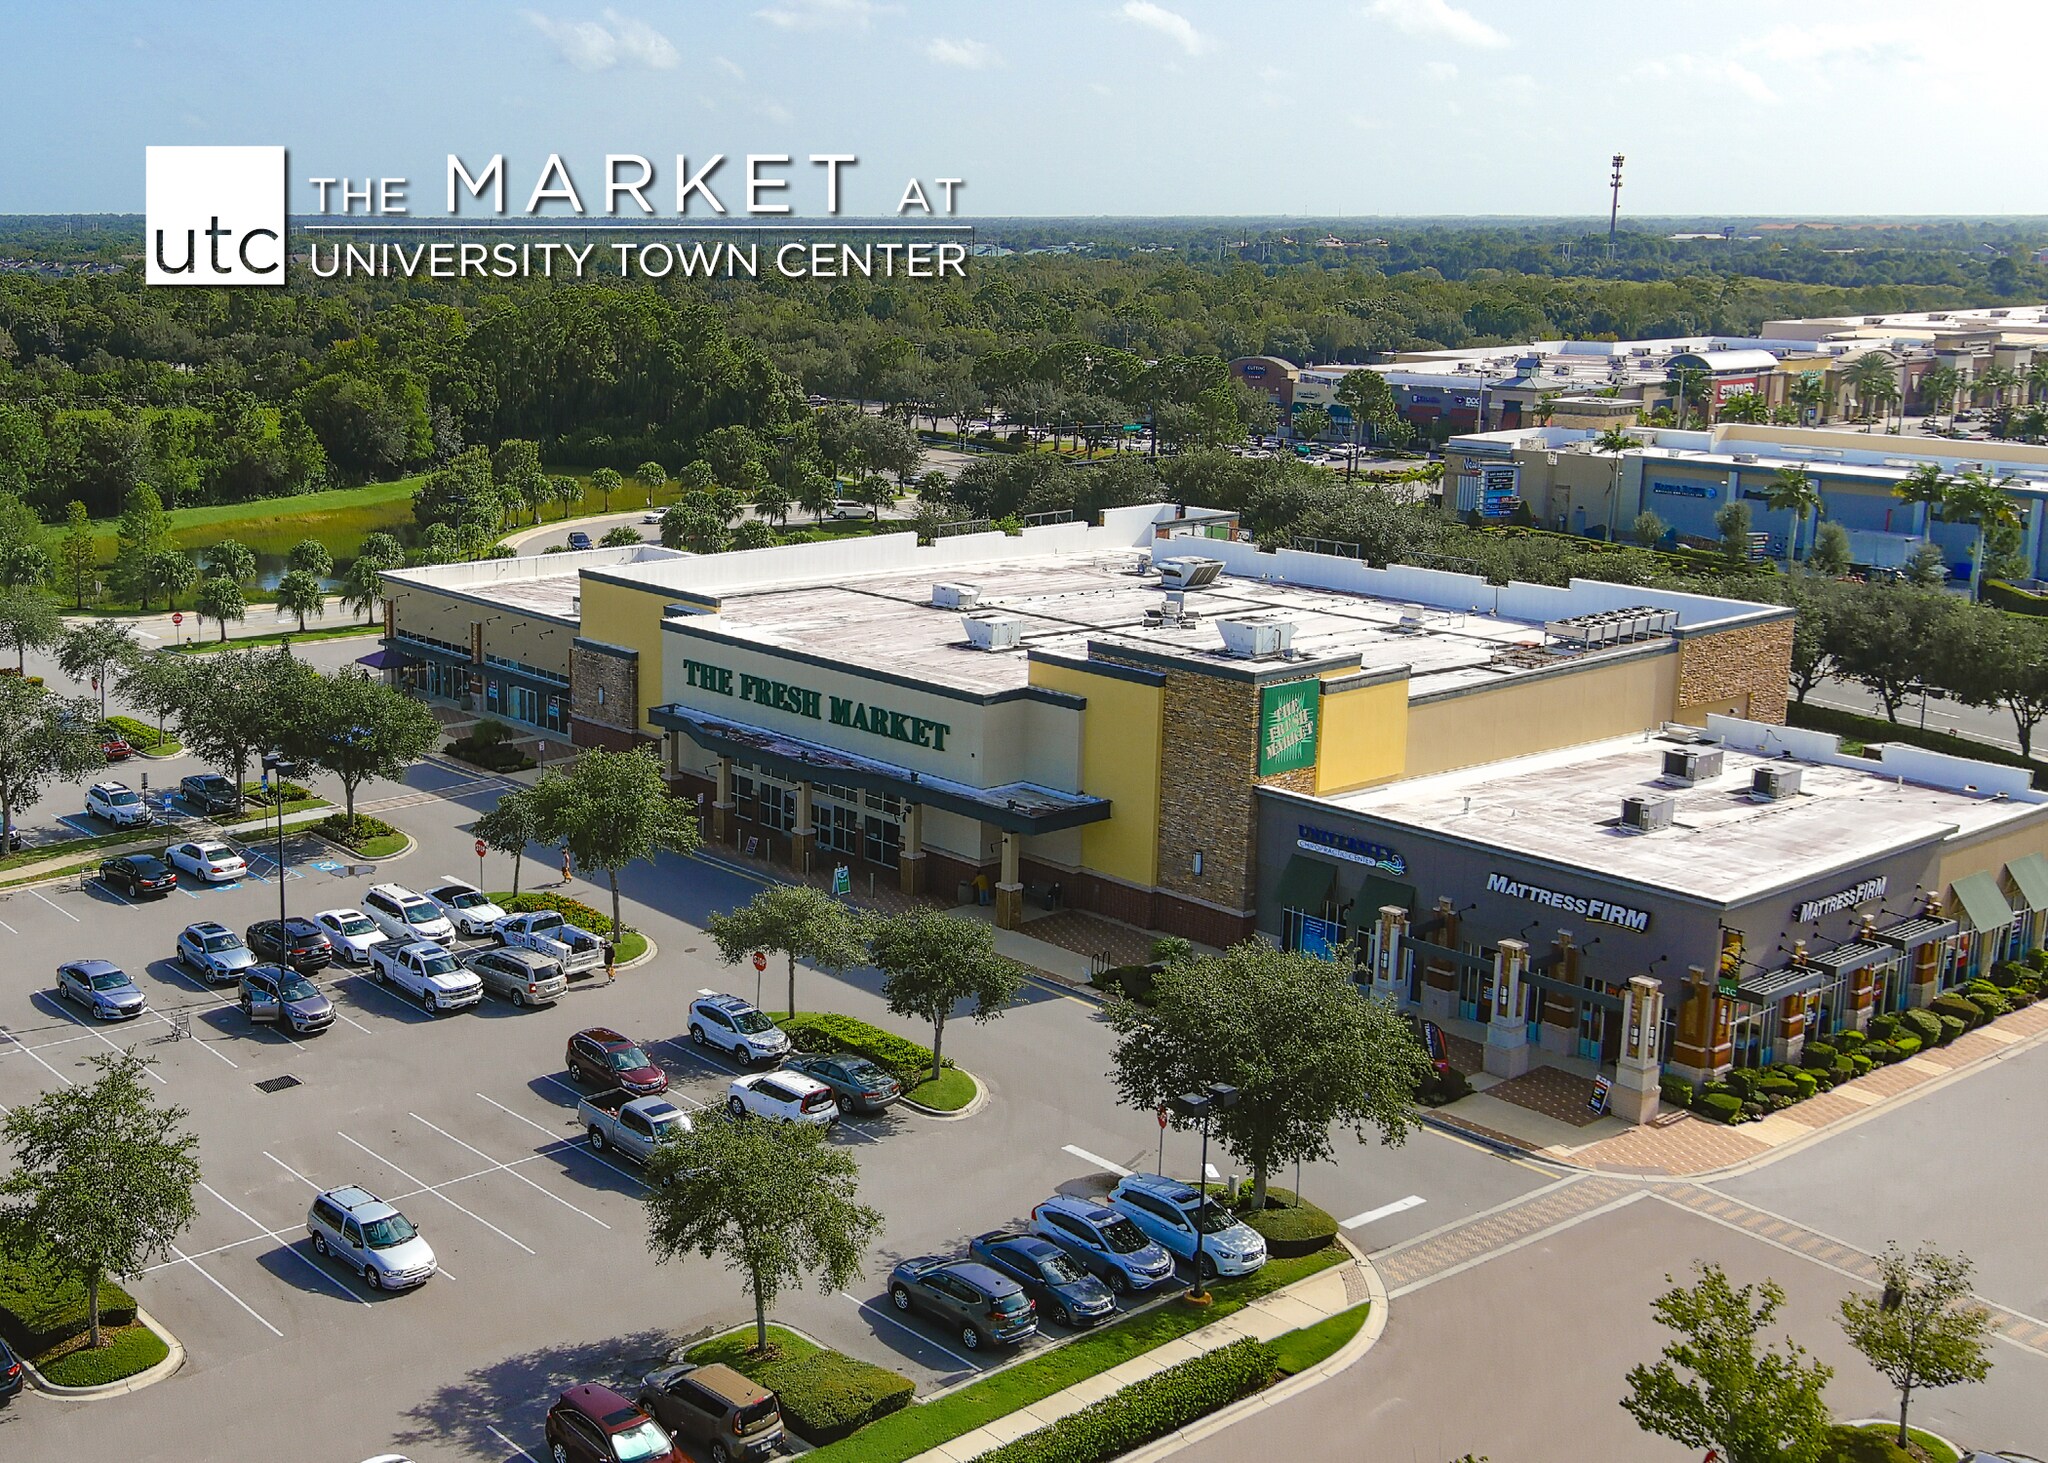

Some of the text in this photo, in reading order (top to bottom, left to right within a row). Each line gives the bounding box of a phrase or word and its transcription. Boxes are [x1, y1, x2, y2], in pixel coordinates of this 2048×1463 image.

[683, 659, 950, 752] THE FRESH MARKET
[1348, 852, 1374, 865] CENTER
[1718, 985, 1737, 997] utc
